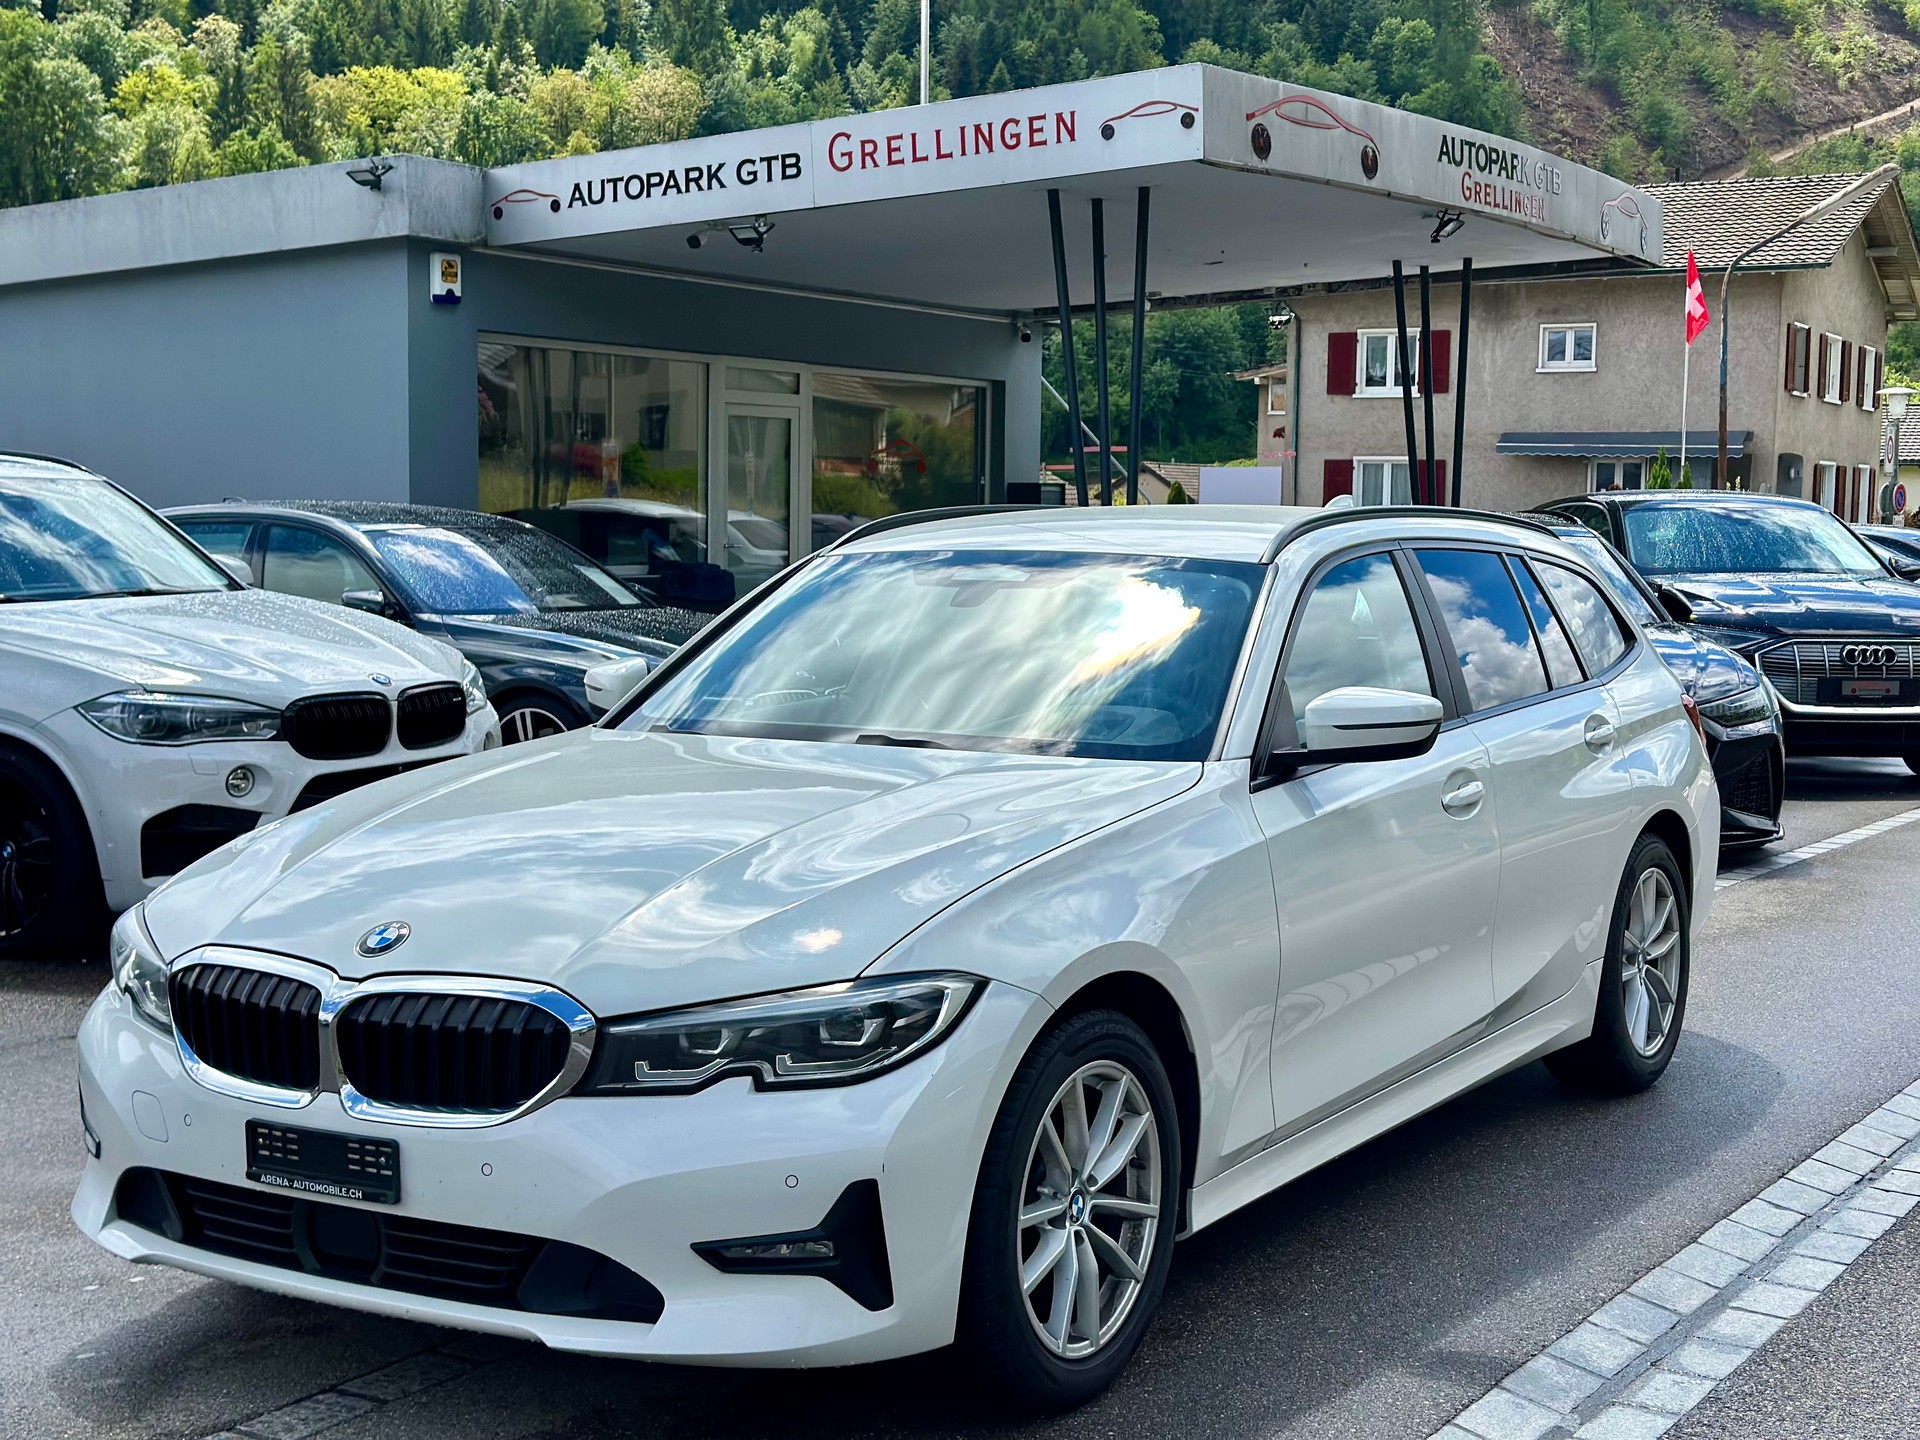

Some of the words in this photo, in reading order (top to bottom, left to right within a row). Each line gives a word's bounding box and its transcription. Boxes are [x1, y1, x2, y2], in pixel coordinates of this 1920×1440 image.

[828, 110, 1077, 172] GRELLINGEN
[1438, 134, 1531, 187] AUTOPARK
[1534, 160, 1562, 196] GTB
[567, 162, 727, 208] AUTOPARK
[736, 152, 802, 186] GTB
[1461, 171, 1545, 222] GRELLINGEN
[260, 1174, 363, 1199] ARENA-AUTOMOBILE.CH
